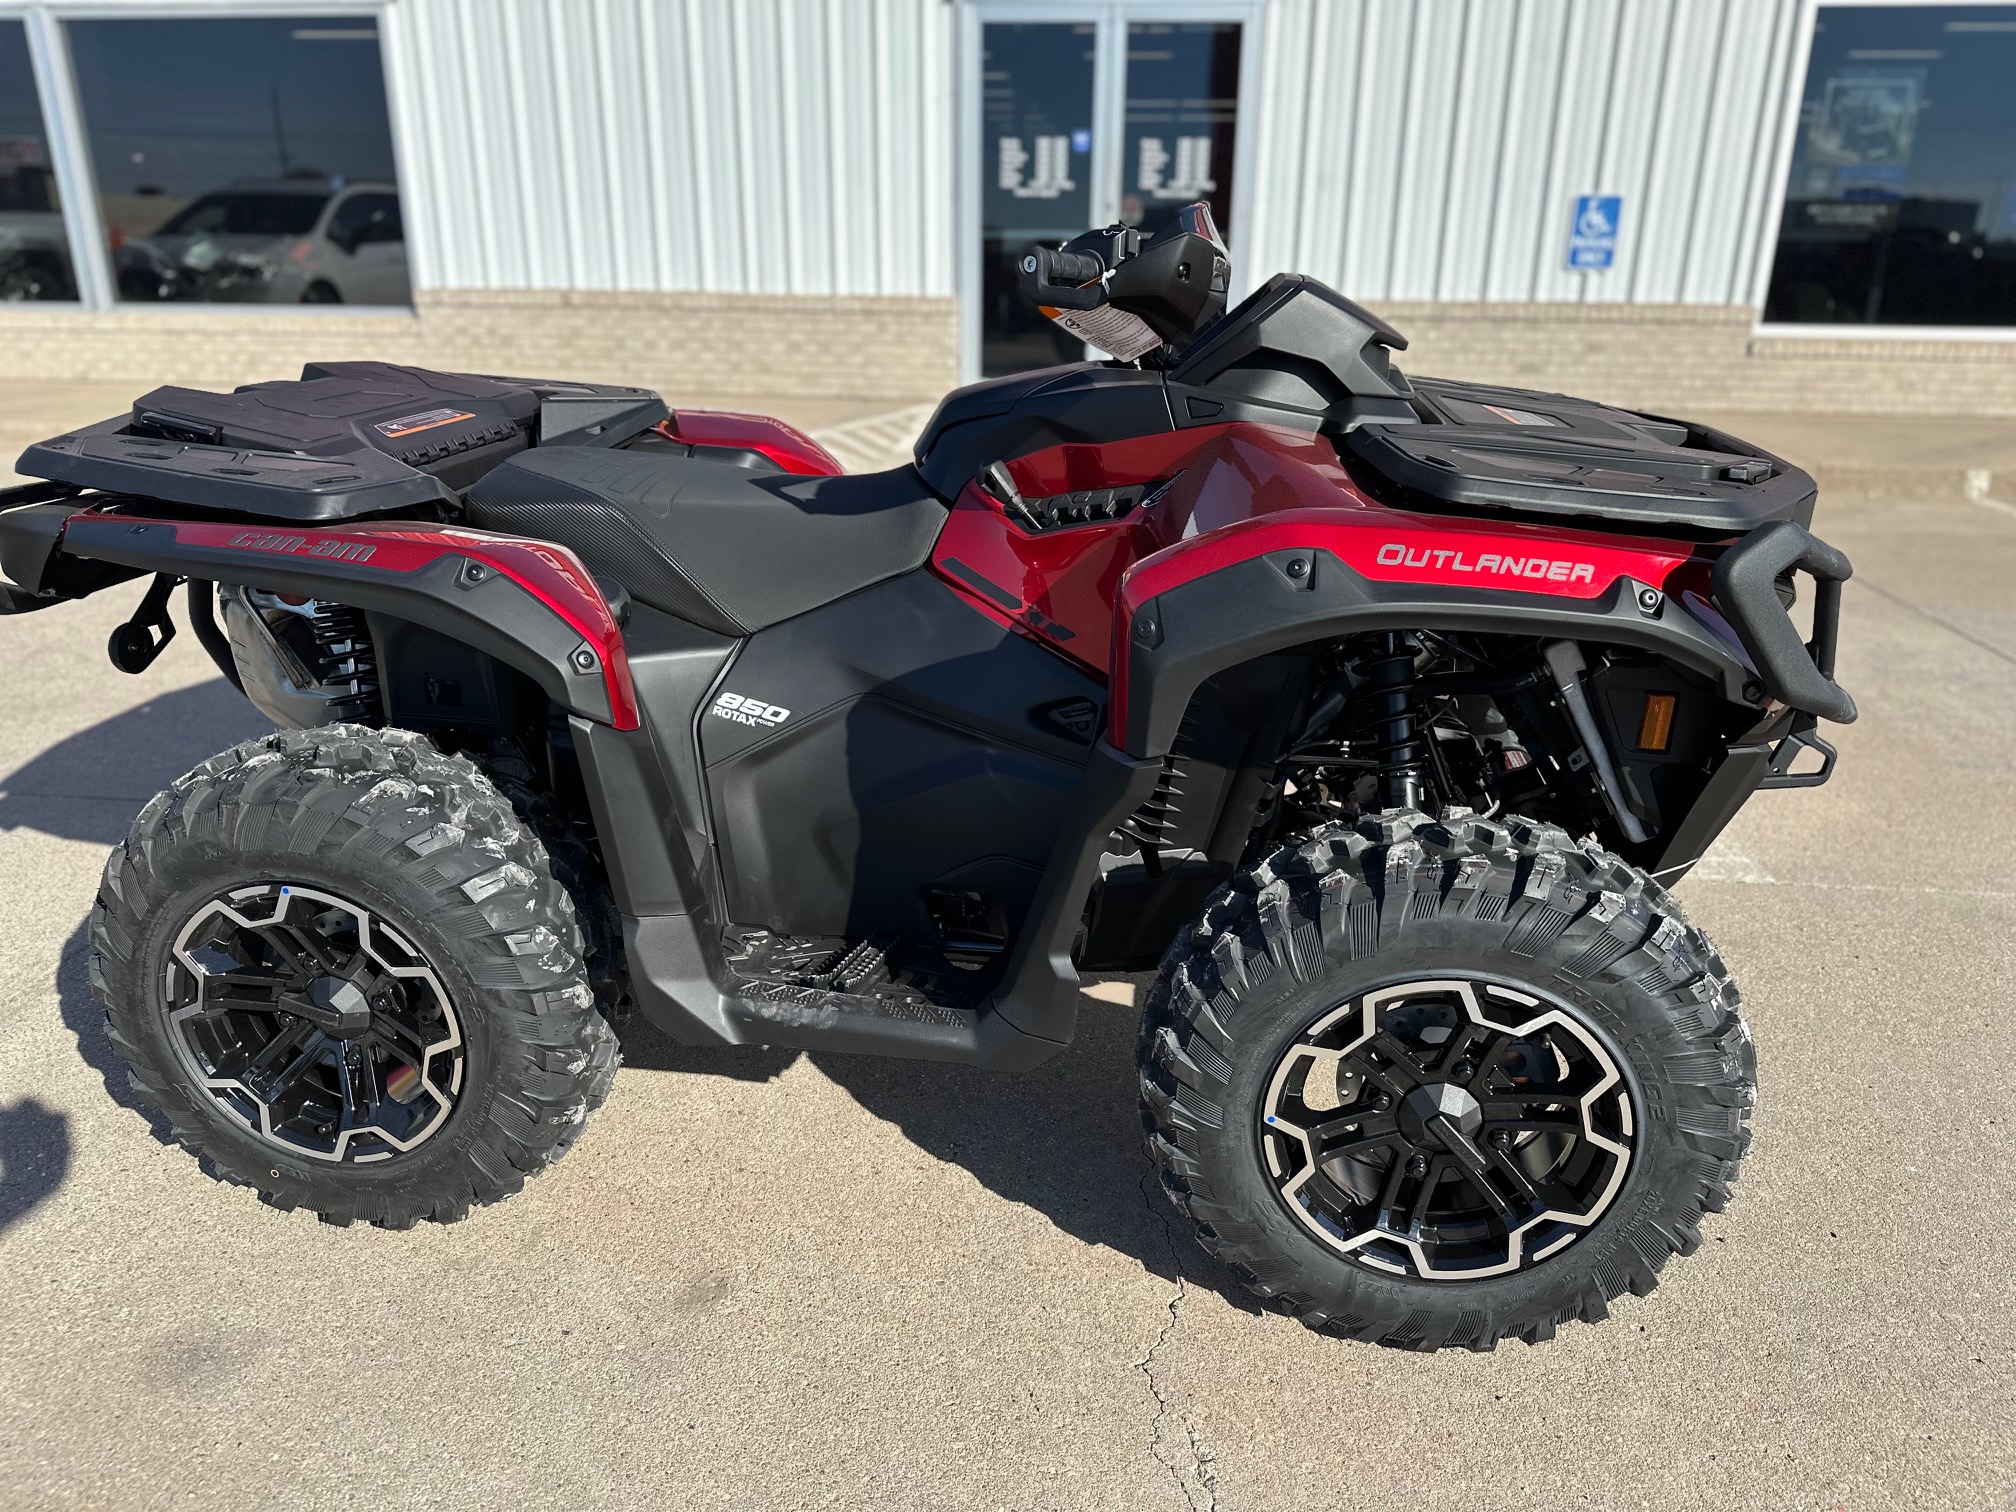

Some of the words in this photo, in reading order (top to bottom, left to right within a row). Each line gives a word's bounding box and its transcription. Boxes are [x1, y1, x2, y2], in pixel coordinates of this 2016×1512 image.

[227, 532, 378, 562] can-am
[1376, 543, 1595, 583] OUTLANDER
[712, 705, 758, 727] ROTAX
[716, 692, 791, 723] 850
[1548, 974, 1627, 1036] TRAIL
